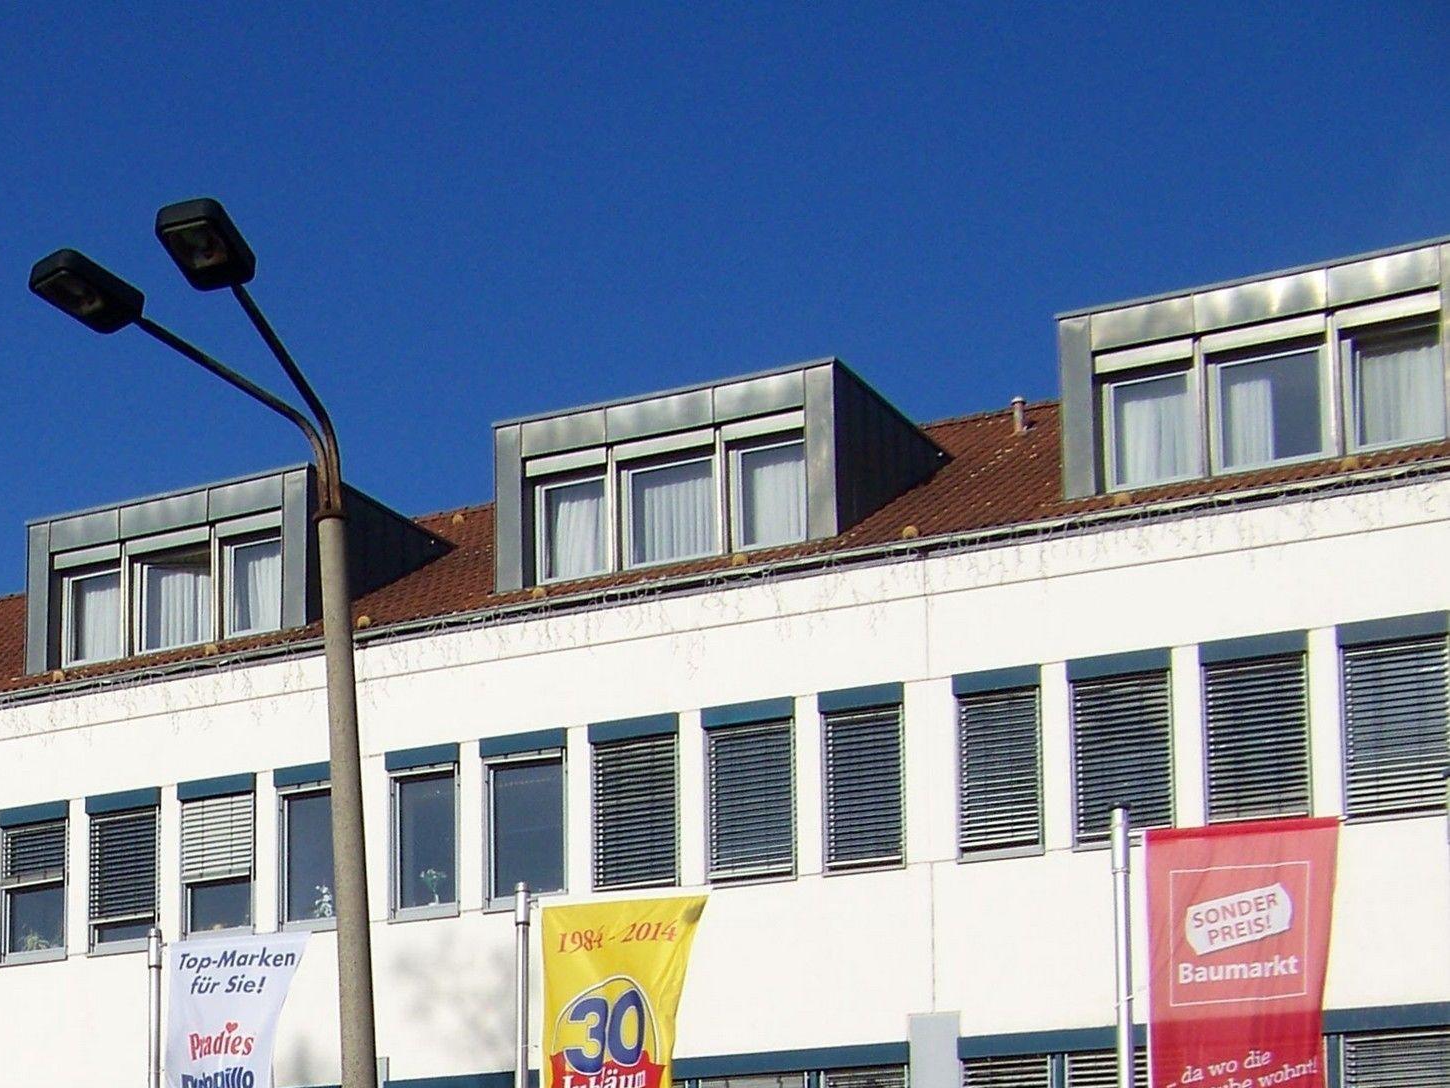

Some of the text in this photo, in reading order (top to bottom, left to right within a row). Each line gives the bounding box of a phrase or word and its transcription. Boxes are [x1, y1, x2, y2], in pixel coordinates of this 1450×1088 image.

[1192, 892, 1279, 929] SONDER
[558, 929, 603, 953] 1984
[620, 919, 677, 943] 2014
[1207, 914, 1272, 946] PREIS!
[179, 947, 296, 973] Top-Marken
[1178, 954, 1299, 984] Baumarkt
[190, 974, 266, 995] für Sie!
[564, 989, 645, 1075] 30
[1181, 1065, 1203, 1085] da
[1208, 1060, 1238, 1076] wo
[1243, 1049, 1272, 1070] die
[1257, 1056, 1318, 1088] wohnt!
